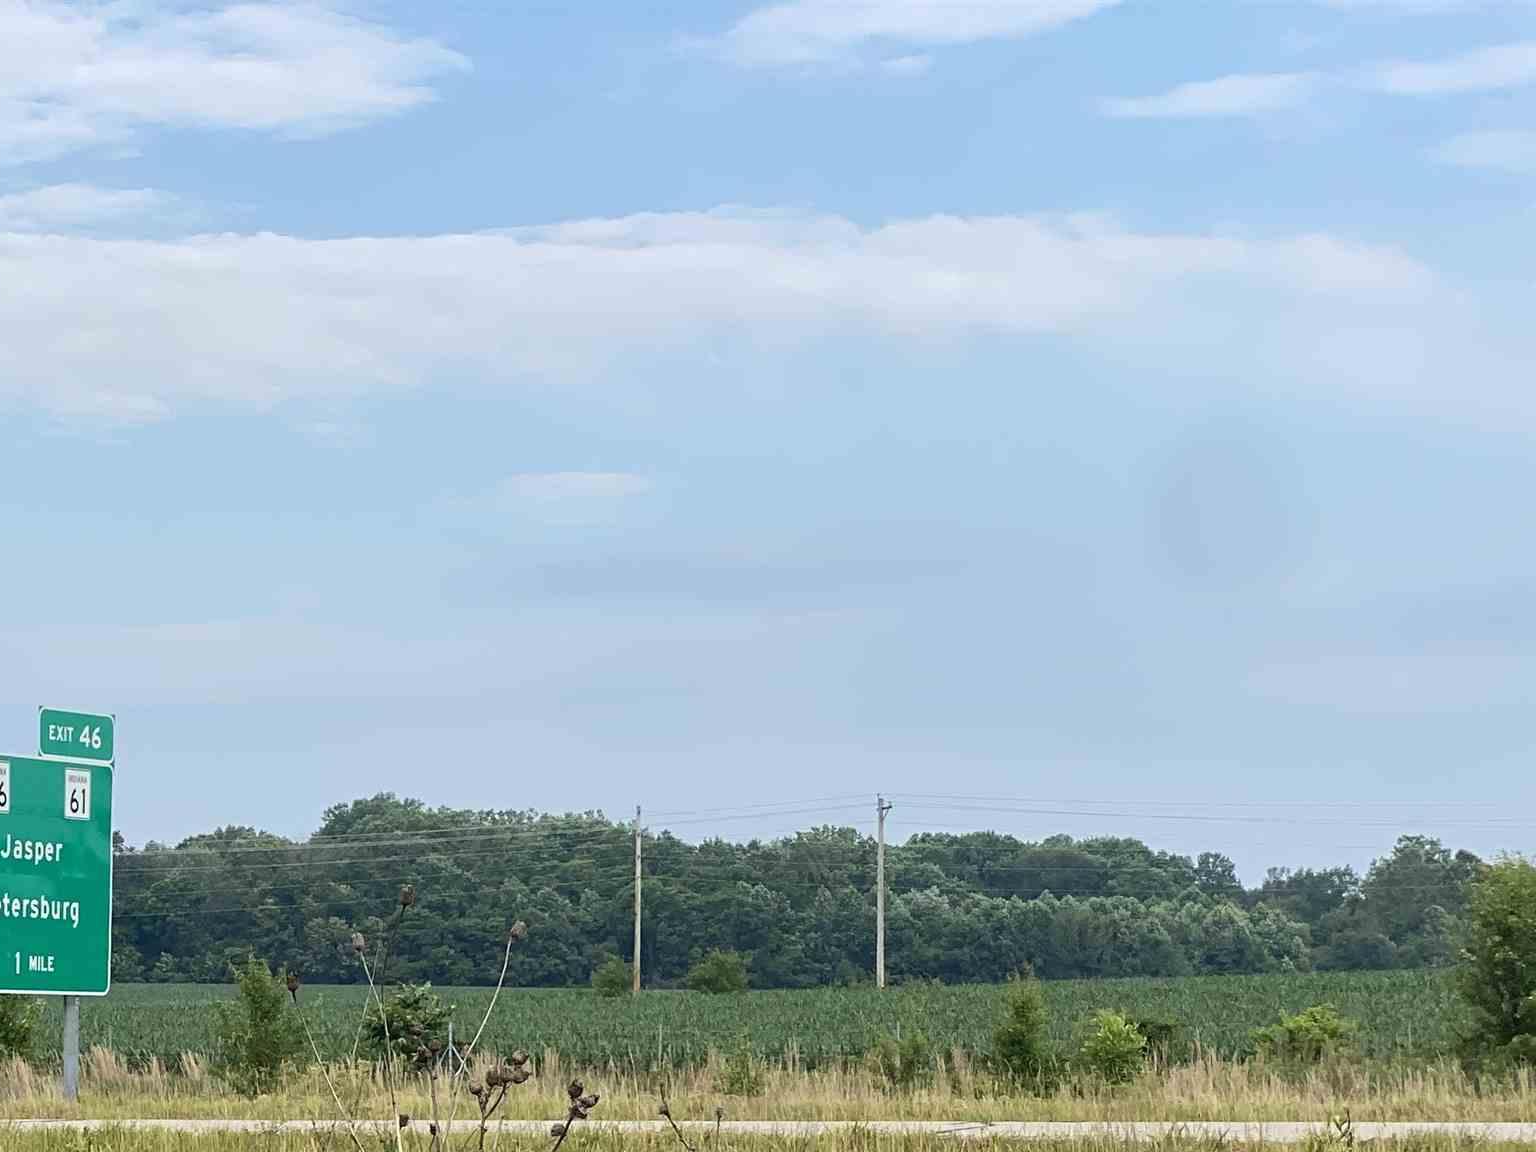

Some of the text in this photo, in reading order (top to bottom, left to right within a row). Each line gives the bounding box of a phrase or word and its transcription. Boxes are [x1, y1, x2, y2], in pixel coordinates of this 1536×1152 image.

[48, 724, 102, 749] EXIT 46
[69, 788, 87, 815] 61
[0, 833, 63, 865] Jasper
[15, 951, 55, 974] 1 MILE
